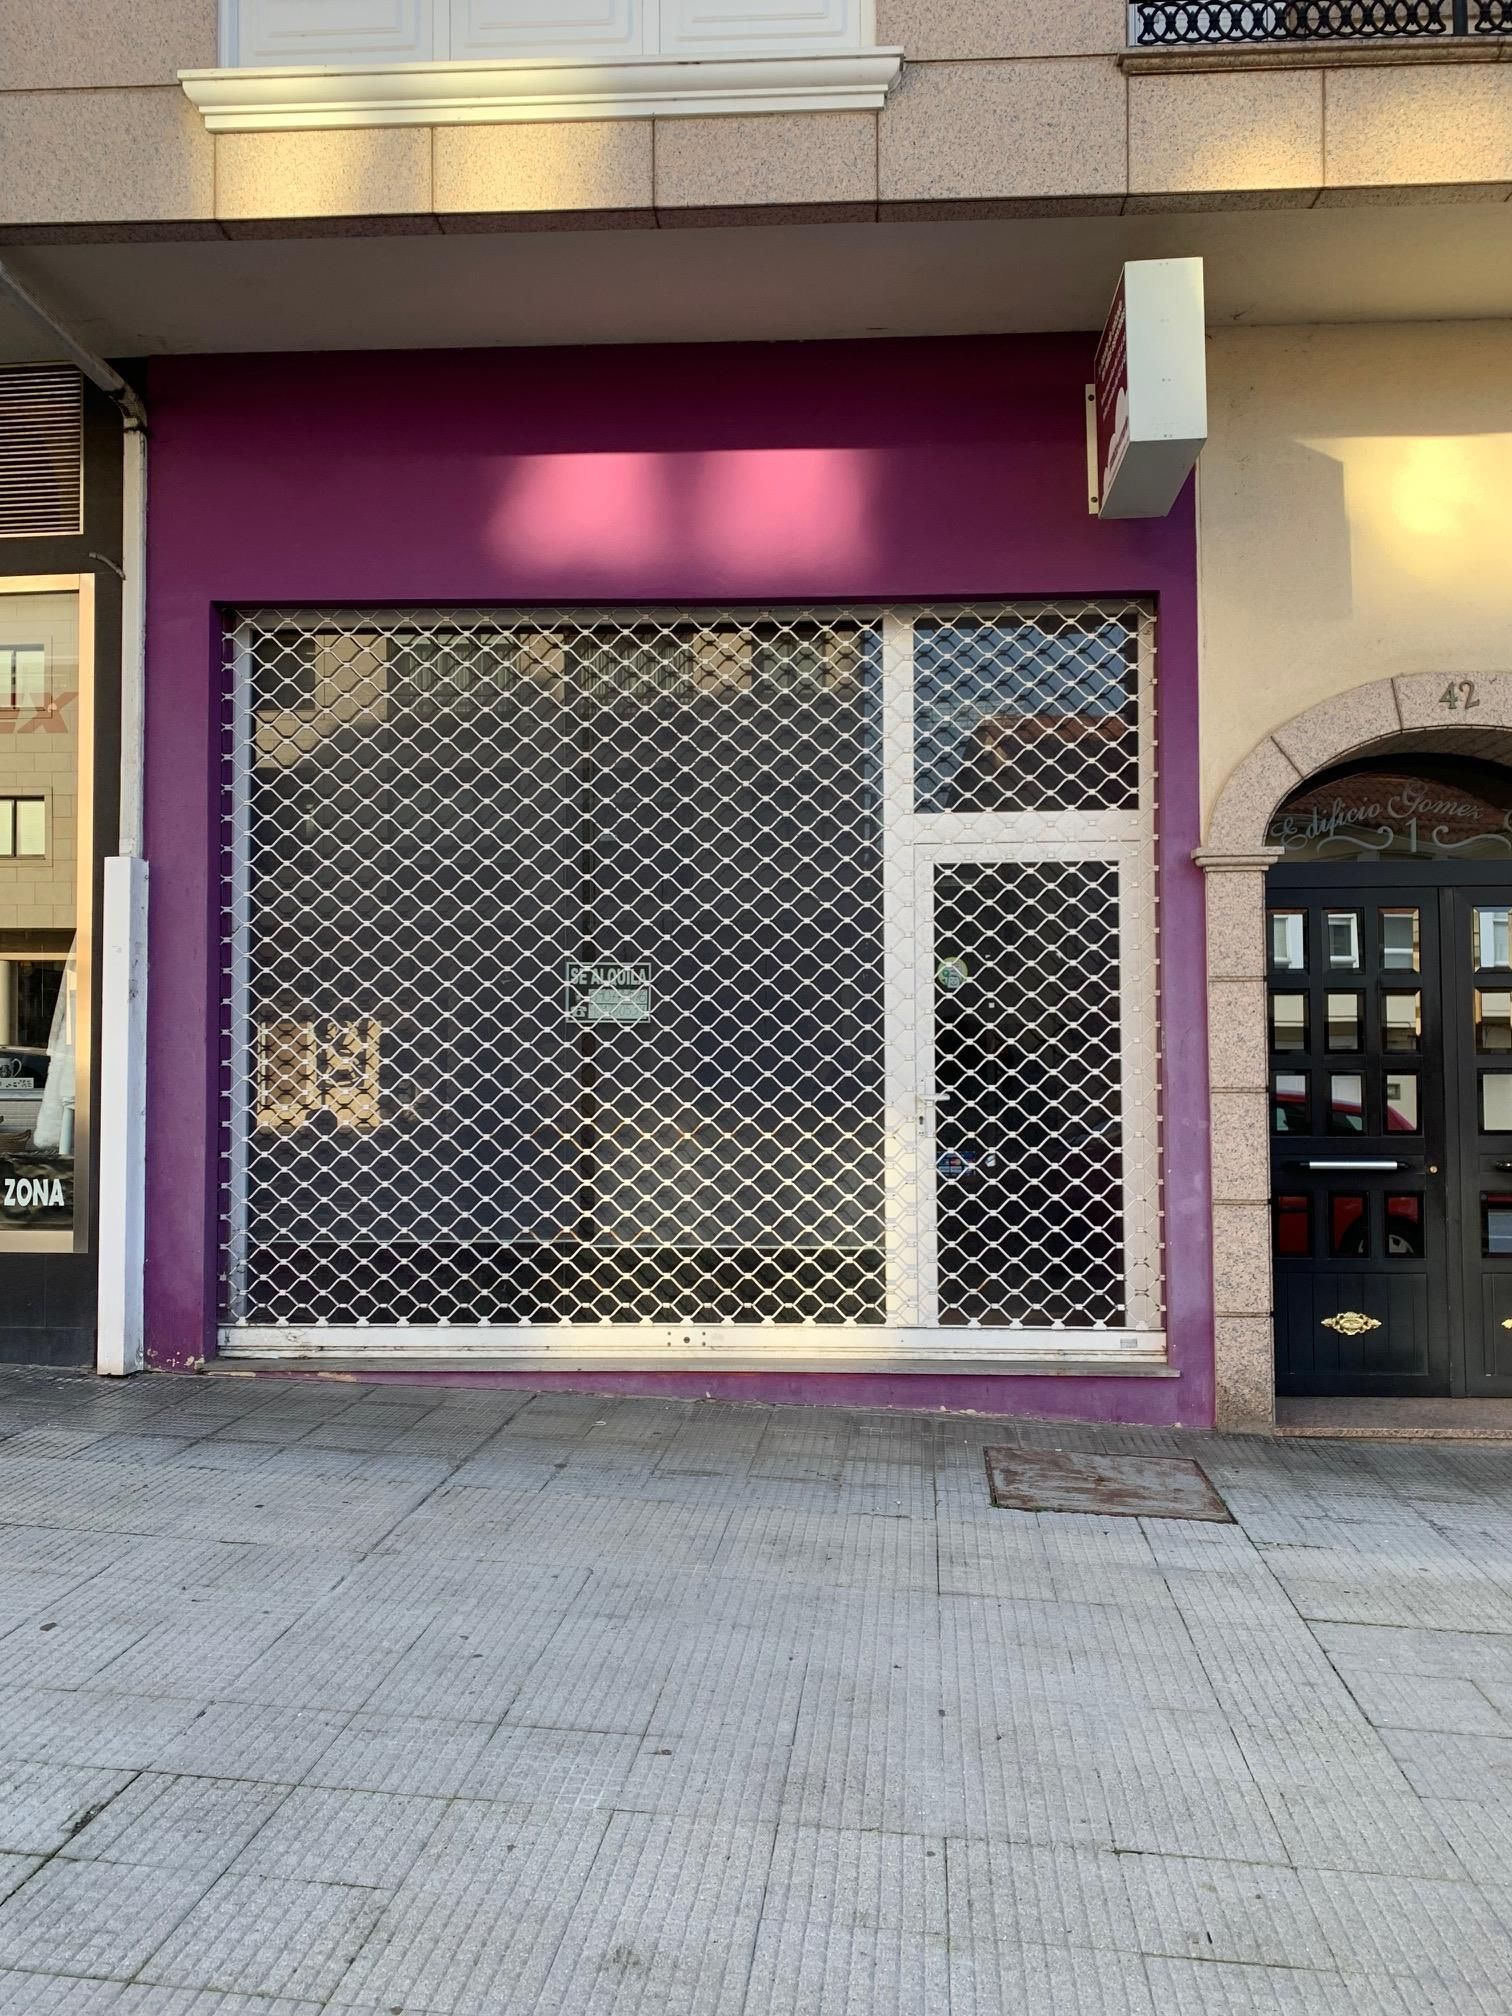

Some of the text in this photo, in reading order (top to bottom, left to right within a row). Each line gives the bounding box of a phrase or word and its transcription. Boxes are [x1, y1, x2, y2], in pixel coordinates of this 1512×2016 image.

[1439, 680, 1480, 710] 42
[1271, 797, 1382, 850] Edificio
[570, 968, 647, 986] SE ALQUILA
[3, 1177, 65, 1207] ZONA
